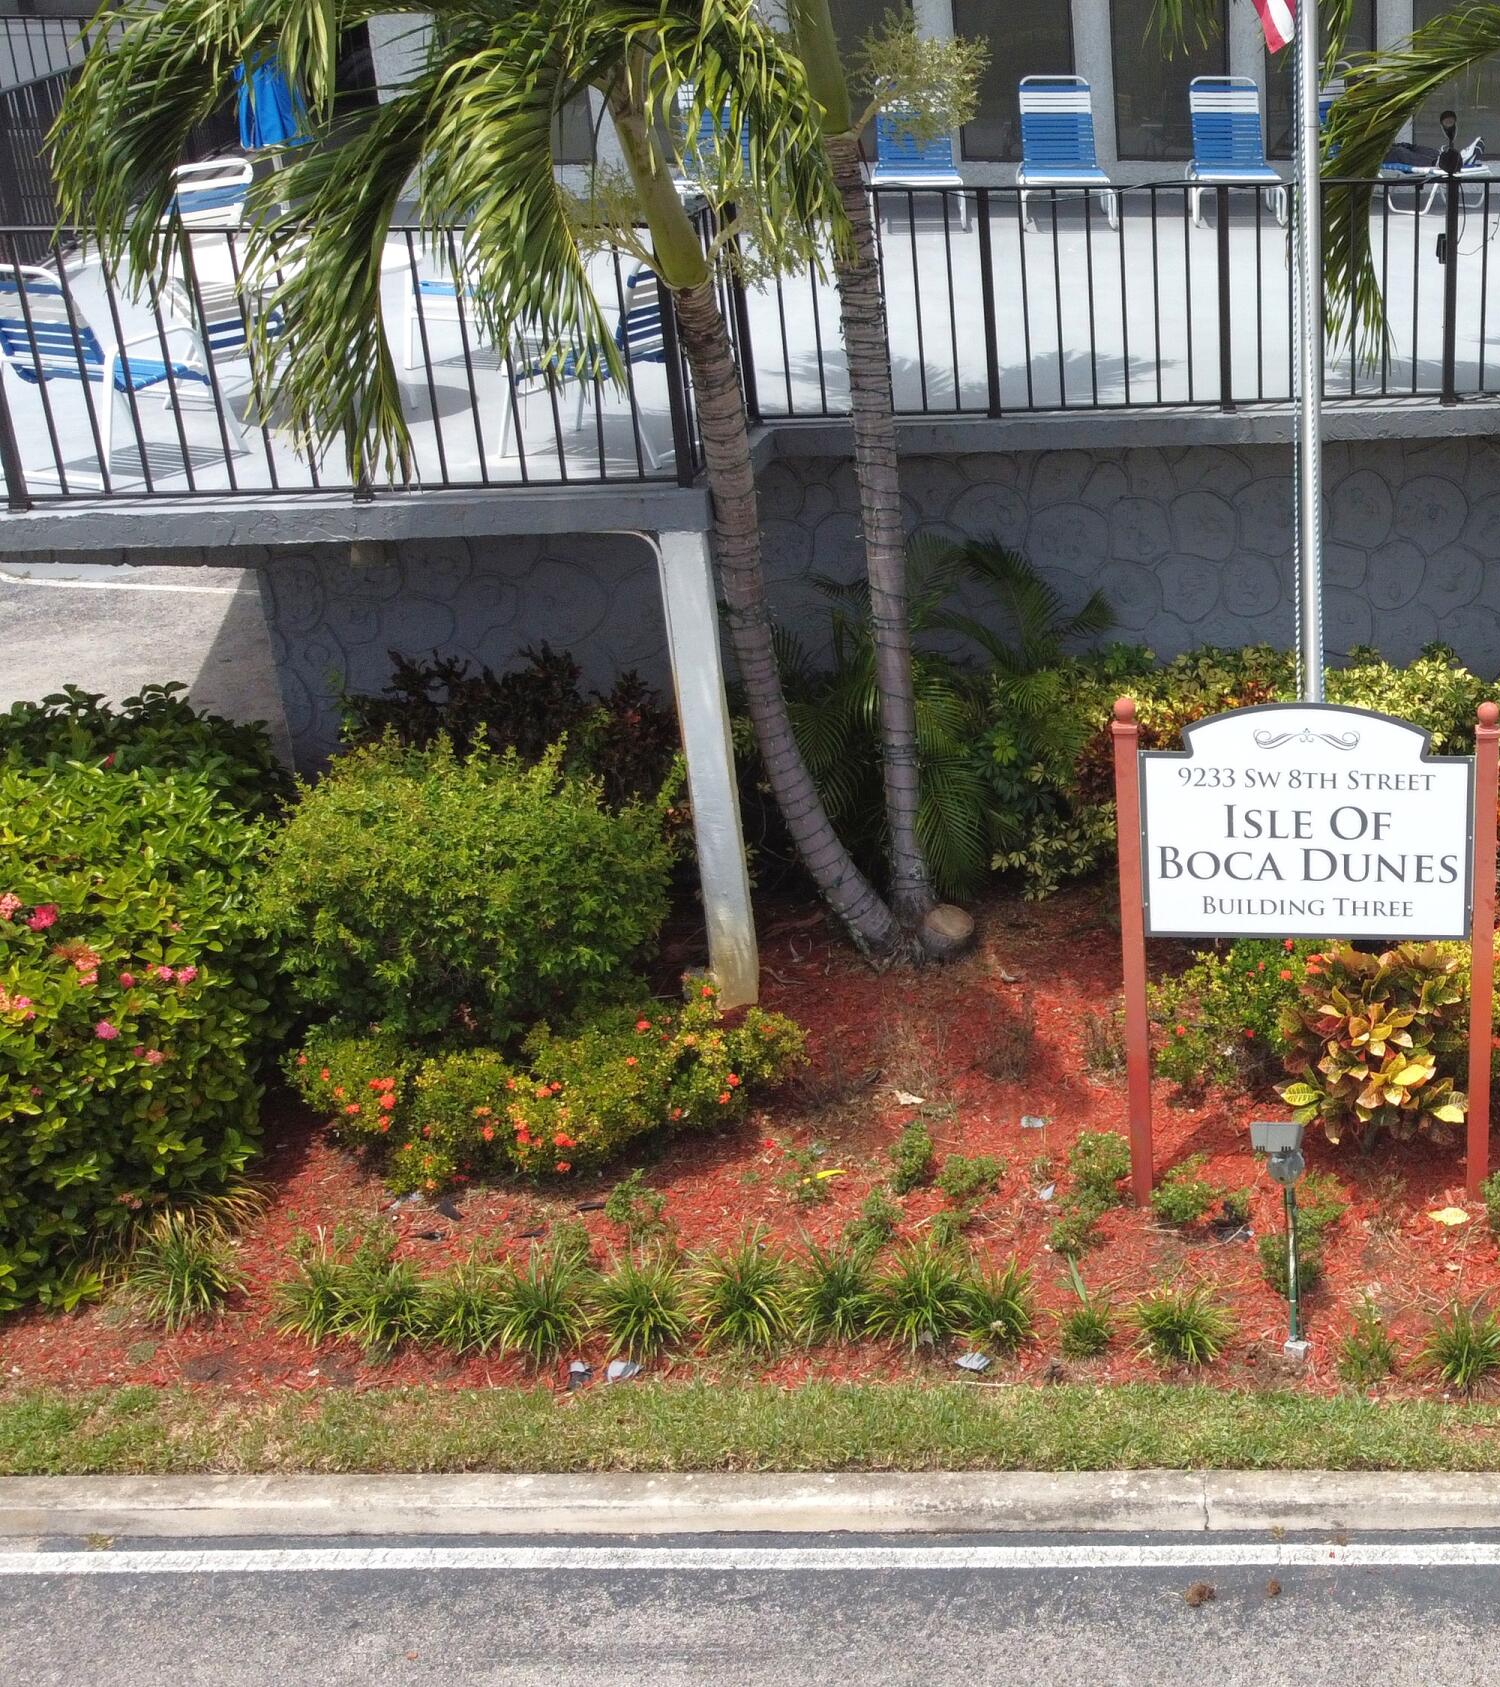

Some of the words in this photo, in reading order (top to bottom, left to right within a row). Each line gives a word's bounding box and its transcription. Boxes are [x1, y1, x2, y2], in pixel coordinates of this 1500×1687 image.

[1177, 766, 1236, 789] 9233
[1244, 767, 1281, 789] SW
[1288, 769, 1337, 790] 8TH
[1348, 770, 1436, 791] STREET
[1224, 804, 1313, 840] ISLE
[1329, 805, 1392, 841] OF
[1158, 846, 1285, 881] BOCA
[1300, 848, 1458, 884] DUNES
[1203, 895, 1325, 917] BUILDING
[1333, 897, 1414, 917] THREE
